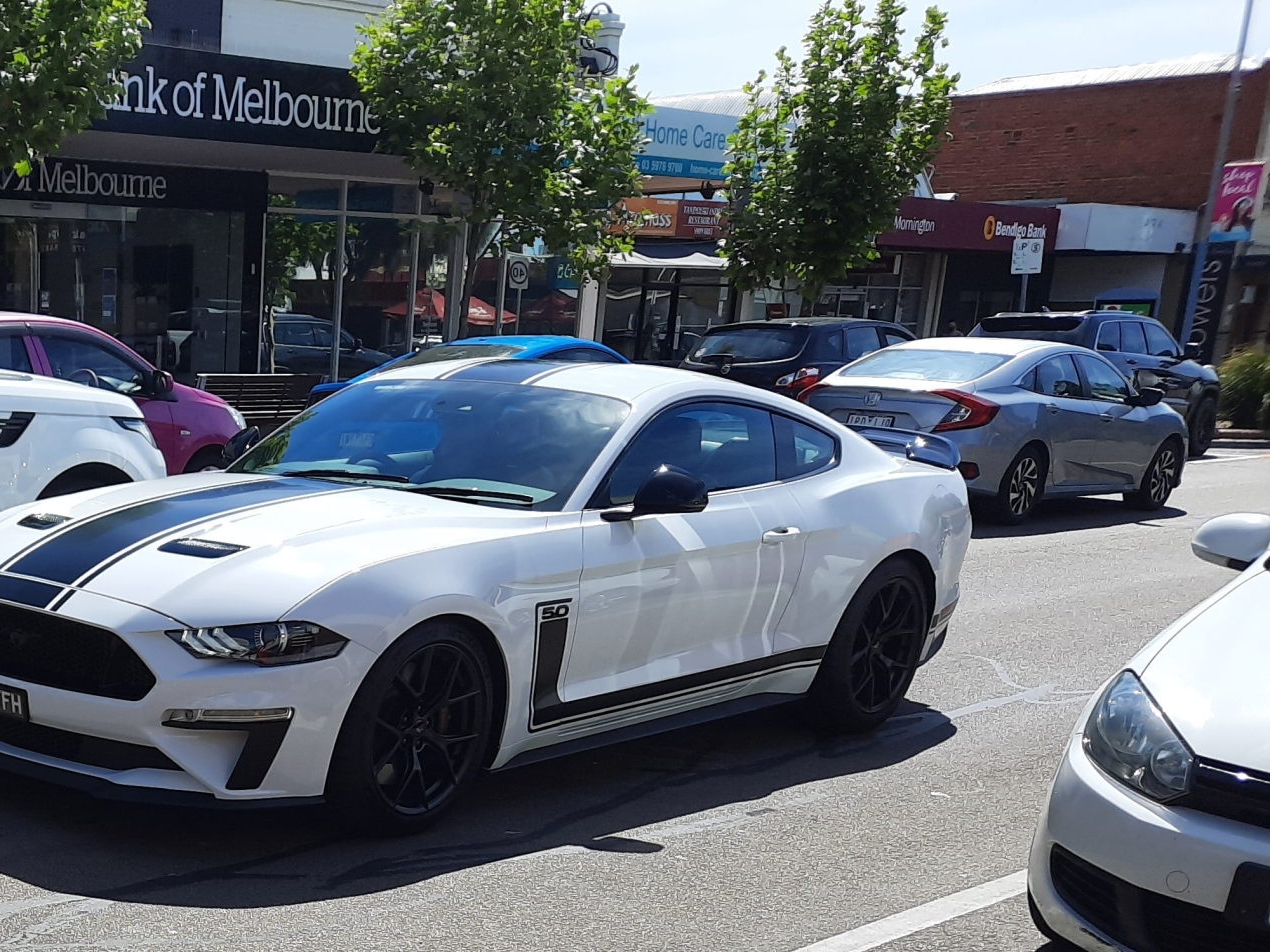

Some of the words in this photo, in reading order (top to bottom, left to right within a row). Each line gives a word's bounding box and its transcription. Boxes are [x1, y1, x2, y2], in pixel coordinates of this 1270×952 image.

[172, 72, 208, 119] of
[212, 73, 381, 135] Melbourne
[645, 118, 688, 146] Home
[693, 124, 726, 150] Care
[38, 163, 168, 199] Melbourne
[894, 216, 935, 235] Mornington
[995, 220, 1027, 241] Bendigo
[1027, 222, 1048, 239] Bank
